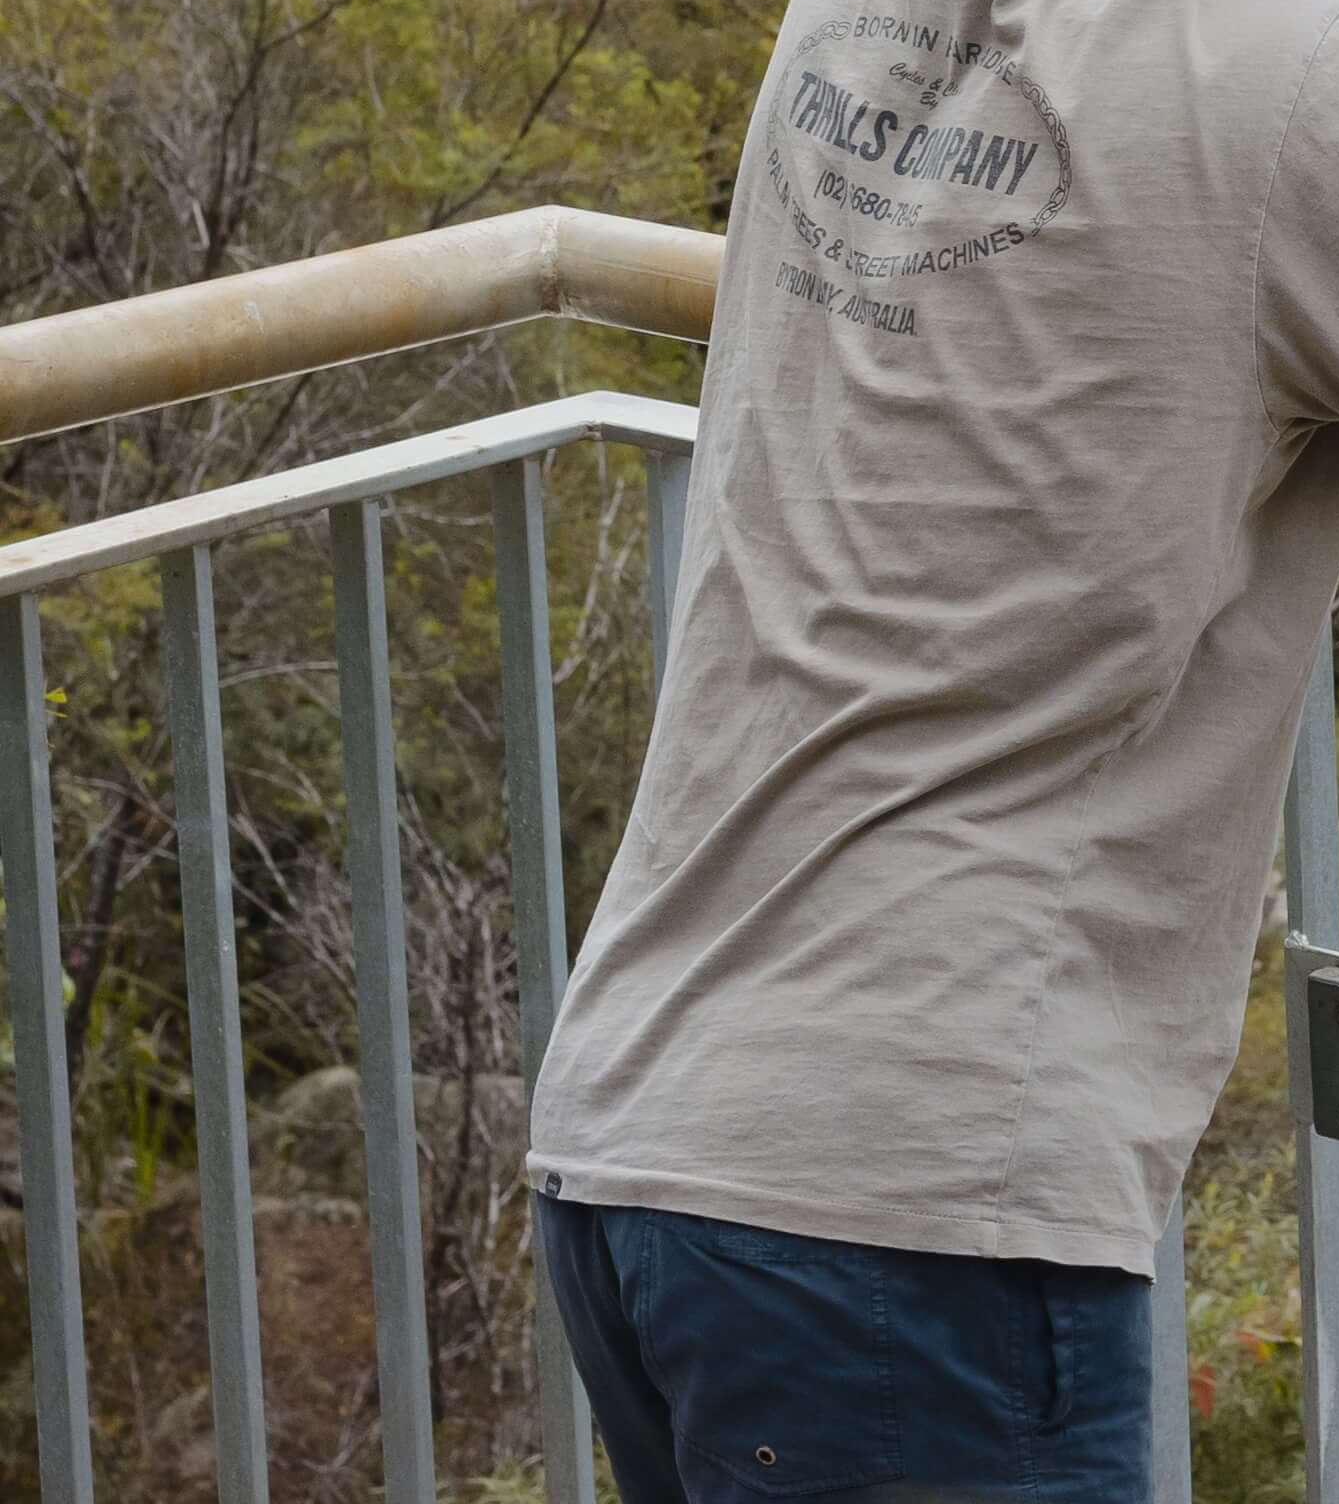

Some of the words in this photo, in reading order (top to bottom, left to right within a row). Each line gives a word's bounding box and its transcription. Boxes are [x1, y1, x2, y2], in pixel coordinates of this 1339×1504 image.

[854, 16, 911, 43] BORN
[912, 23, 940, 52] IN
[788, 71, 898, 162] THRILLS
[894, 124, 1040, 196] COMPANY
[901, 222, 1026, 277] MACHINES
